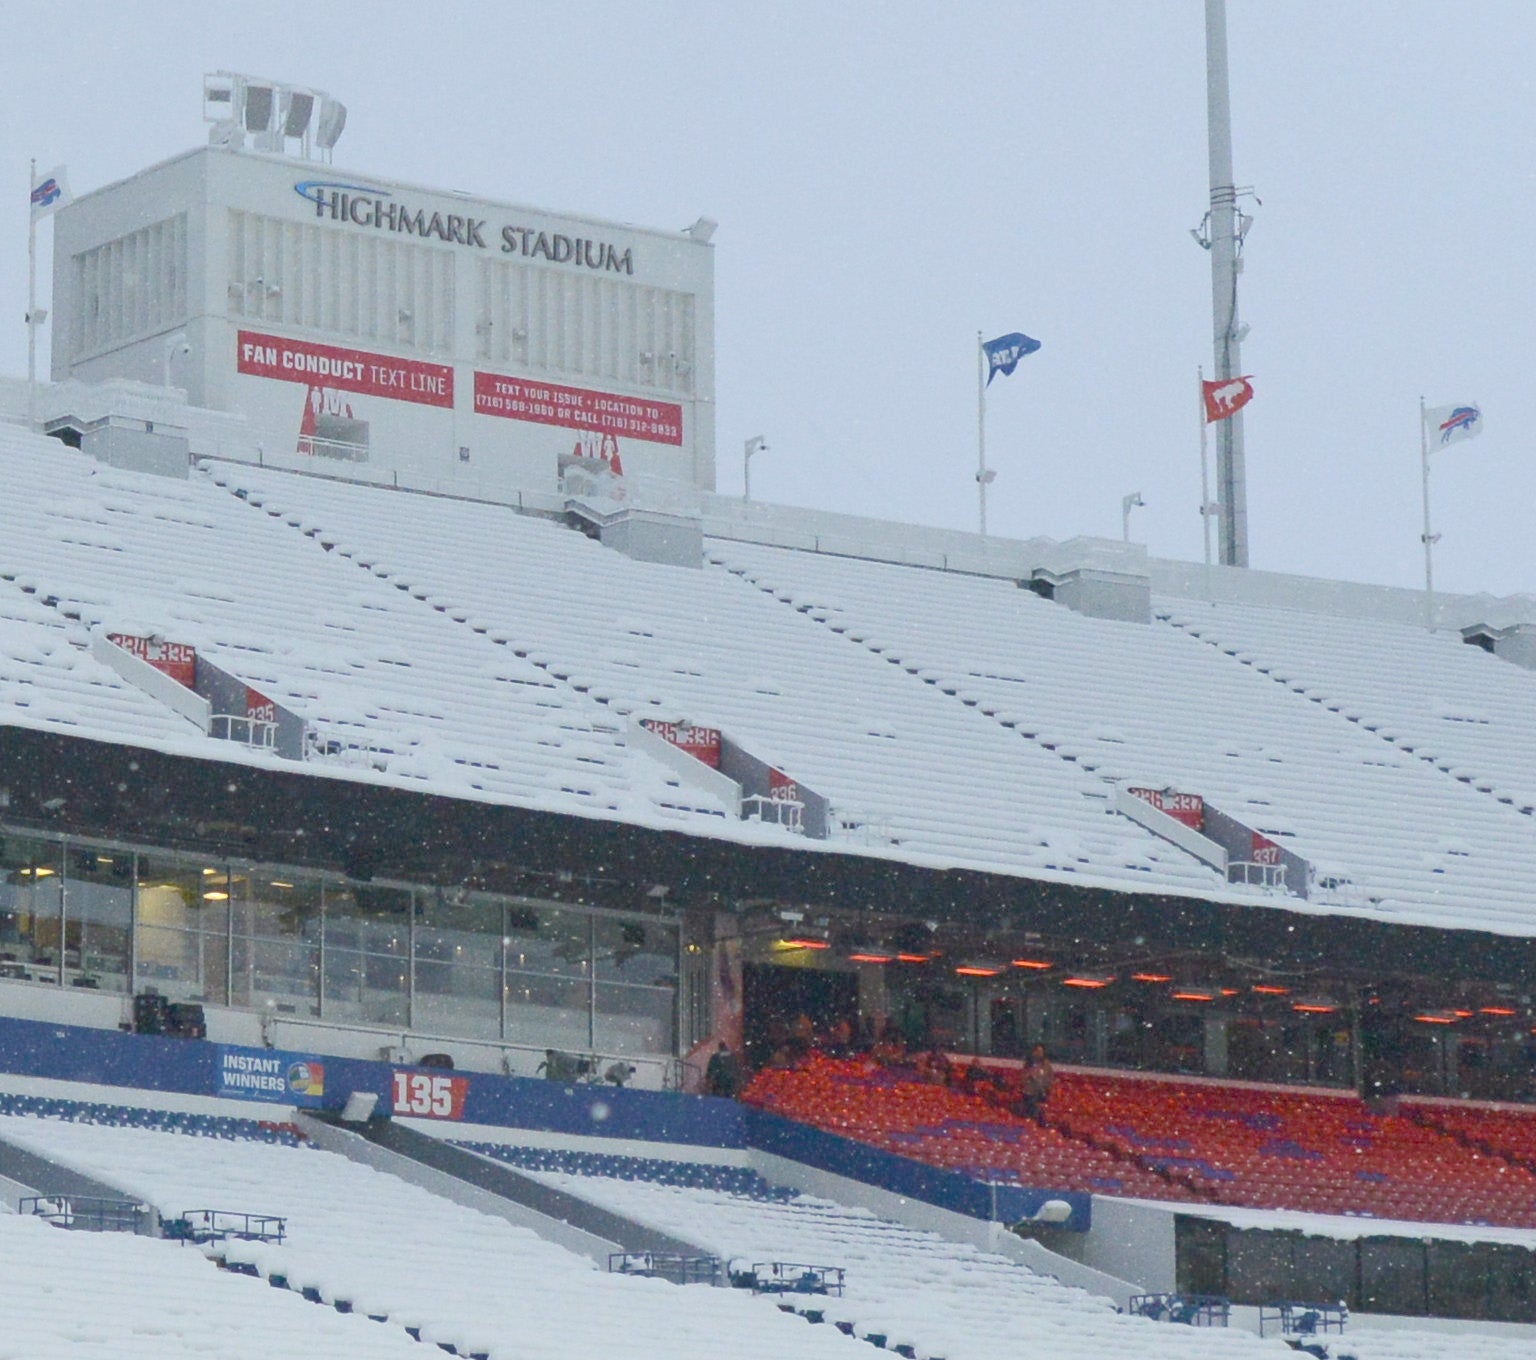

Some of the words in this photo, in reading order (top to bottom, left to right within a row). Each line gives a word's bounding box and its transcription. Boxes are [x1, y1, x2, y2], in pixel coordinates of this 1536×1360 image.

[316, 188, 487, 249] HIGHMARK
[500, 224, 635, 275] STADIUM
[243, 343, 277, 366] FAN
[282, 350, 365, 380] CONDUCT
[370, 365, 406, 388] TEXT
[410, 373, 446, 395] LINE
[495, 382, 521, 396] TEXT
[523, 387, 550, 400] YOUR
[553, 391, 583, 407] ISSUE
[595, 399, 643, 416] LOCATION
[557, 407, 571, 419] OR
[574, 410, 598, 423] CALL
[223, 1054, 280, 1074] INSTANT
[223, 1072, 285, 1092] WINNERS
[393, 1073, 452, 1116] 135
